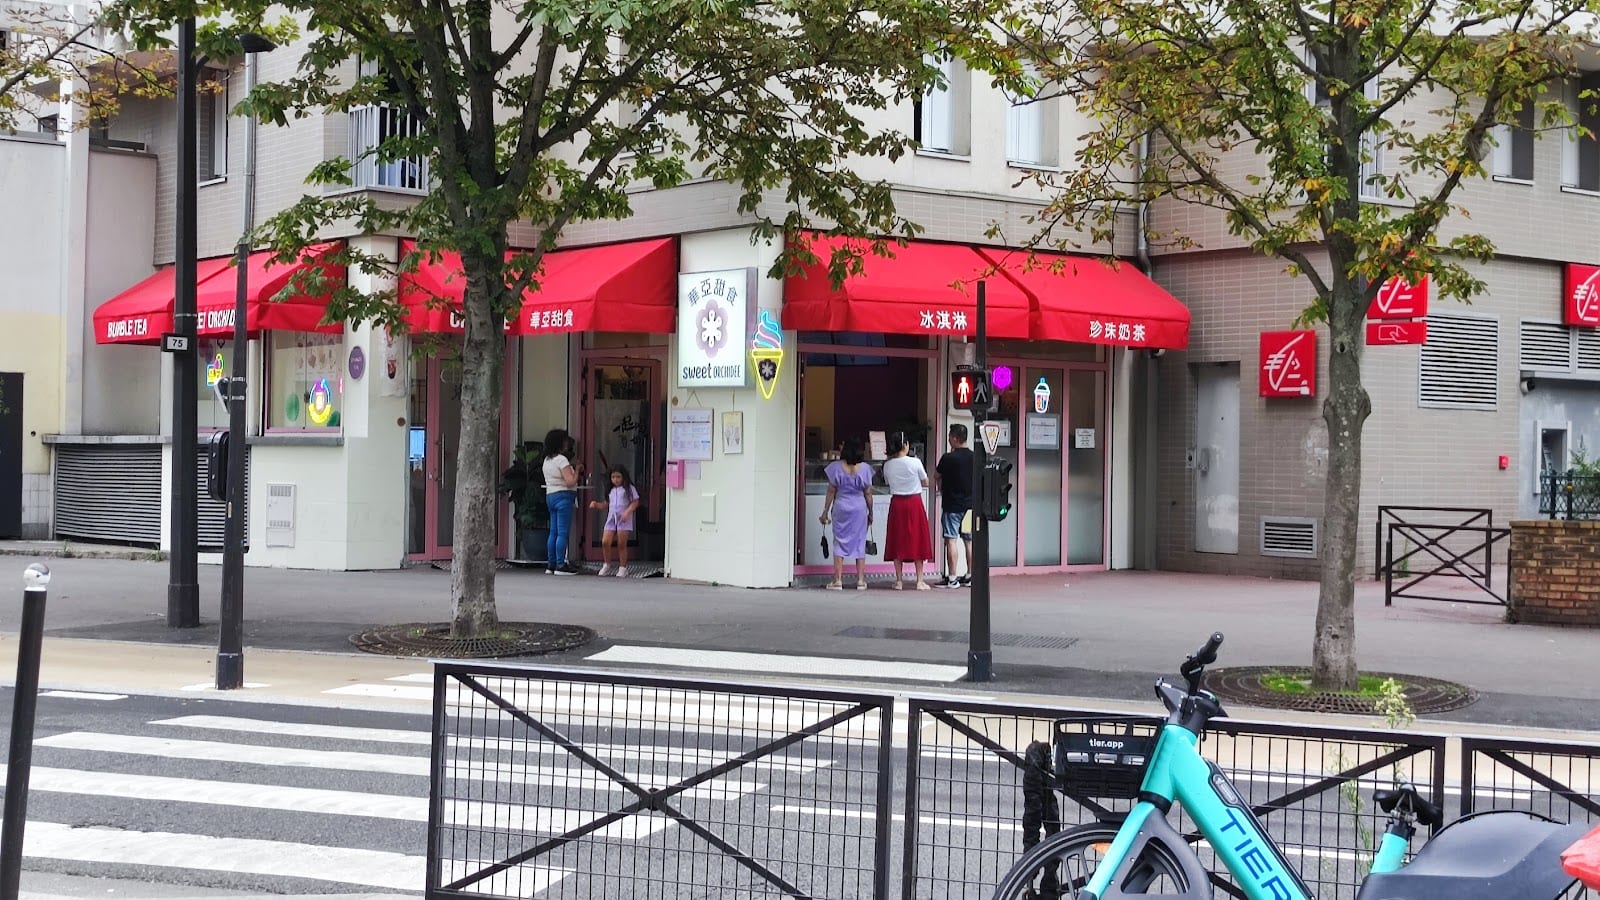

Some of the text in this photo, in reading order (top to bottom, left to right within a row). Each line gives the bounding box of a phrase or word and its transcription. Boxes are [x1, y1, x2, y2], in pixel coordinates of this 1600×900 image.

[688, 278, 738, 307] 華亞甜食
[107, 318, 147, 338] BUBBLE TEA
[530, 309, 574, 329] 華亞甜食
[919, 309, 968, 330] 冰淇淋
[1089, 320, 1146, 341] 珍珠奶茶
[172, 338, 183, 348] 75
[682, 362, 712, 379] sweet
[1089, 738, 1124, 750] tier.app
[1220, 808, 1291, 900] TIER
